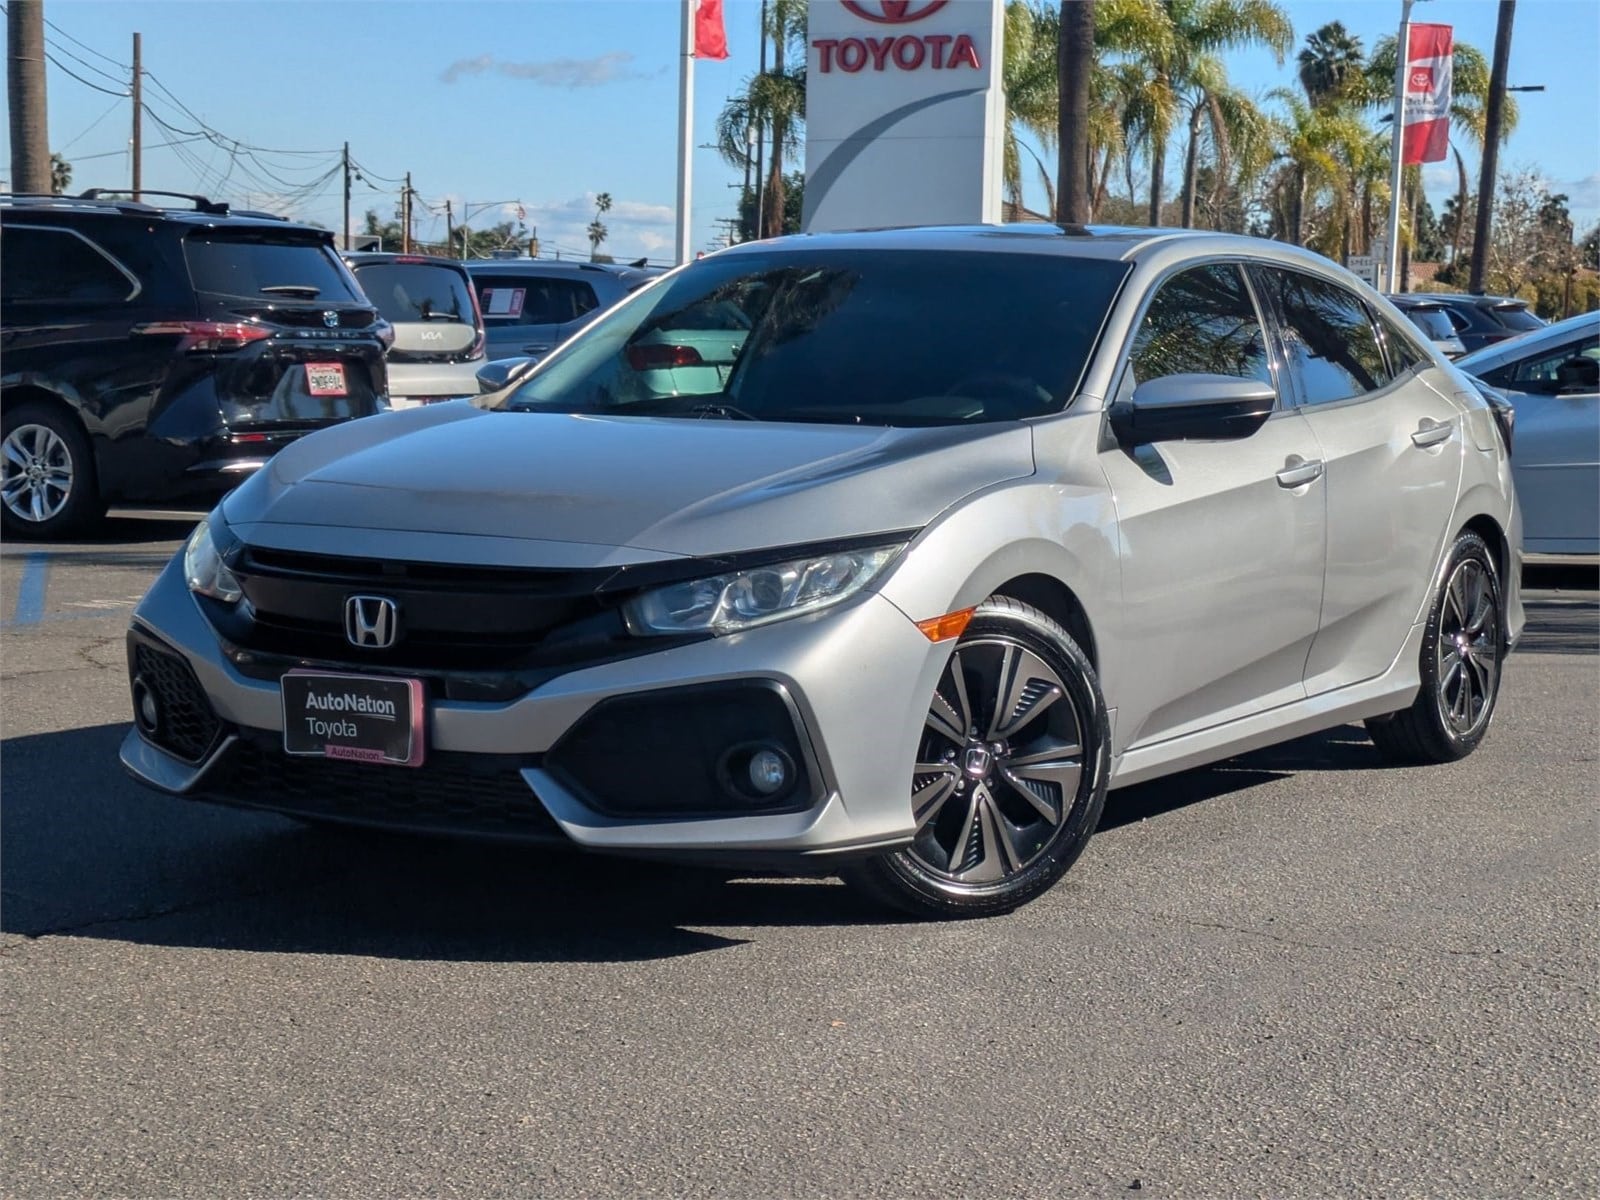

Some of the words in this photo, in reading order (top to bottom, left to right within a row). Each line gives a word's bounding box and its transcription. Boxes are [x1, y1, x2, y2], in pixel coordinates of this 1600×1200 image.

[812, 34, 981, 73] TOYOTA
[305, 691, 396, 714] AutoNation
[305, 717, 357, 739] Toyota
[331, 746, 380, 761] AutoNation
